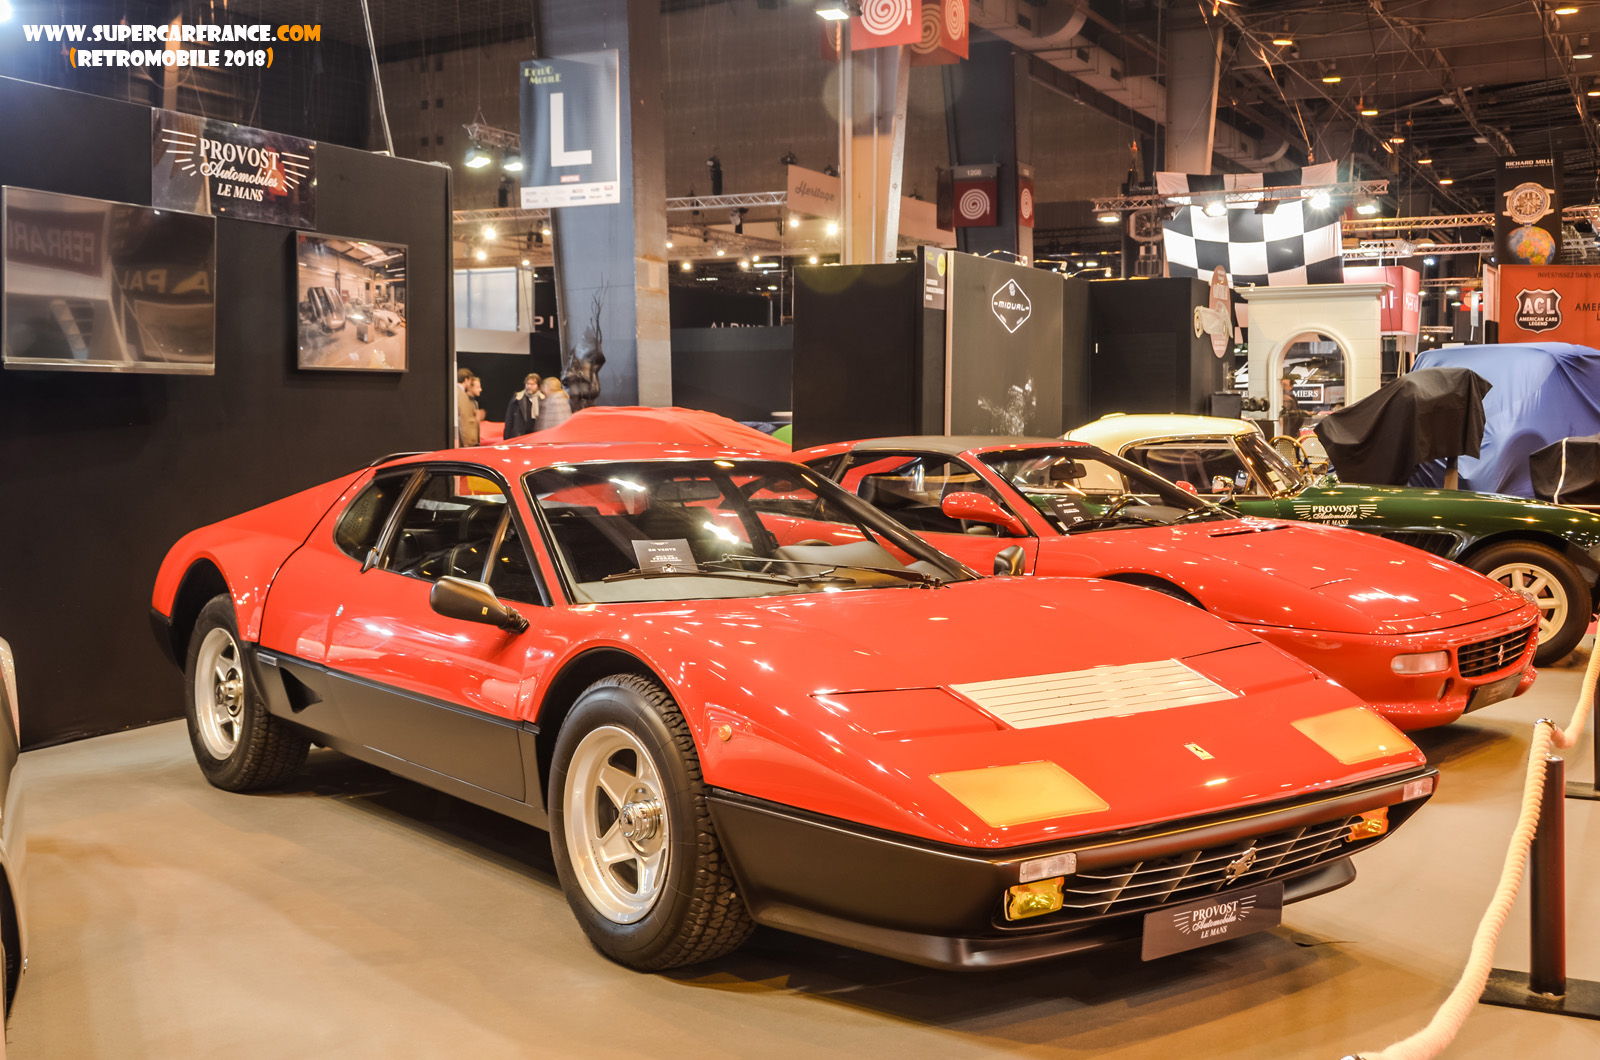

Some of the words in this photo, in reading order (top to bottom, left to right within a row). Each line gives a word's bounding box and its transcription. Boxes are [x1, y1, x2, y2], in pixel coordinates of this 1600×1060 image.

[550, 92, 592, 167] L
[199, 138, 280, 170] PROVOST
[200, 159, 278, 188] Automobiles
[217, 183, 232, 197] LE
[233, 185, 264, 202] MANS
[795, 181, 835, 202] Heritage
[1522, 298, 1555, 315] ACL
[1312, 505, 1358, 513] PROVOST
[1313, 510, 1358, 519] Automobiles
[1192, 901, 1239, 921] PROVOST
[1192, 911, 1237, 932] Automobiles
[1201, 930, 1210, 939] LE
[1210, 925, 1228, 935] MANS
